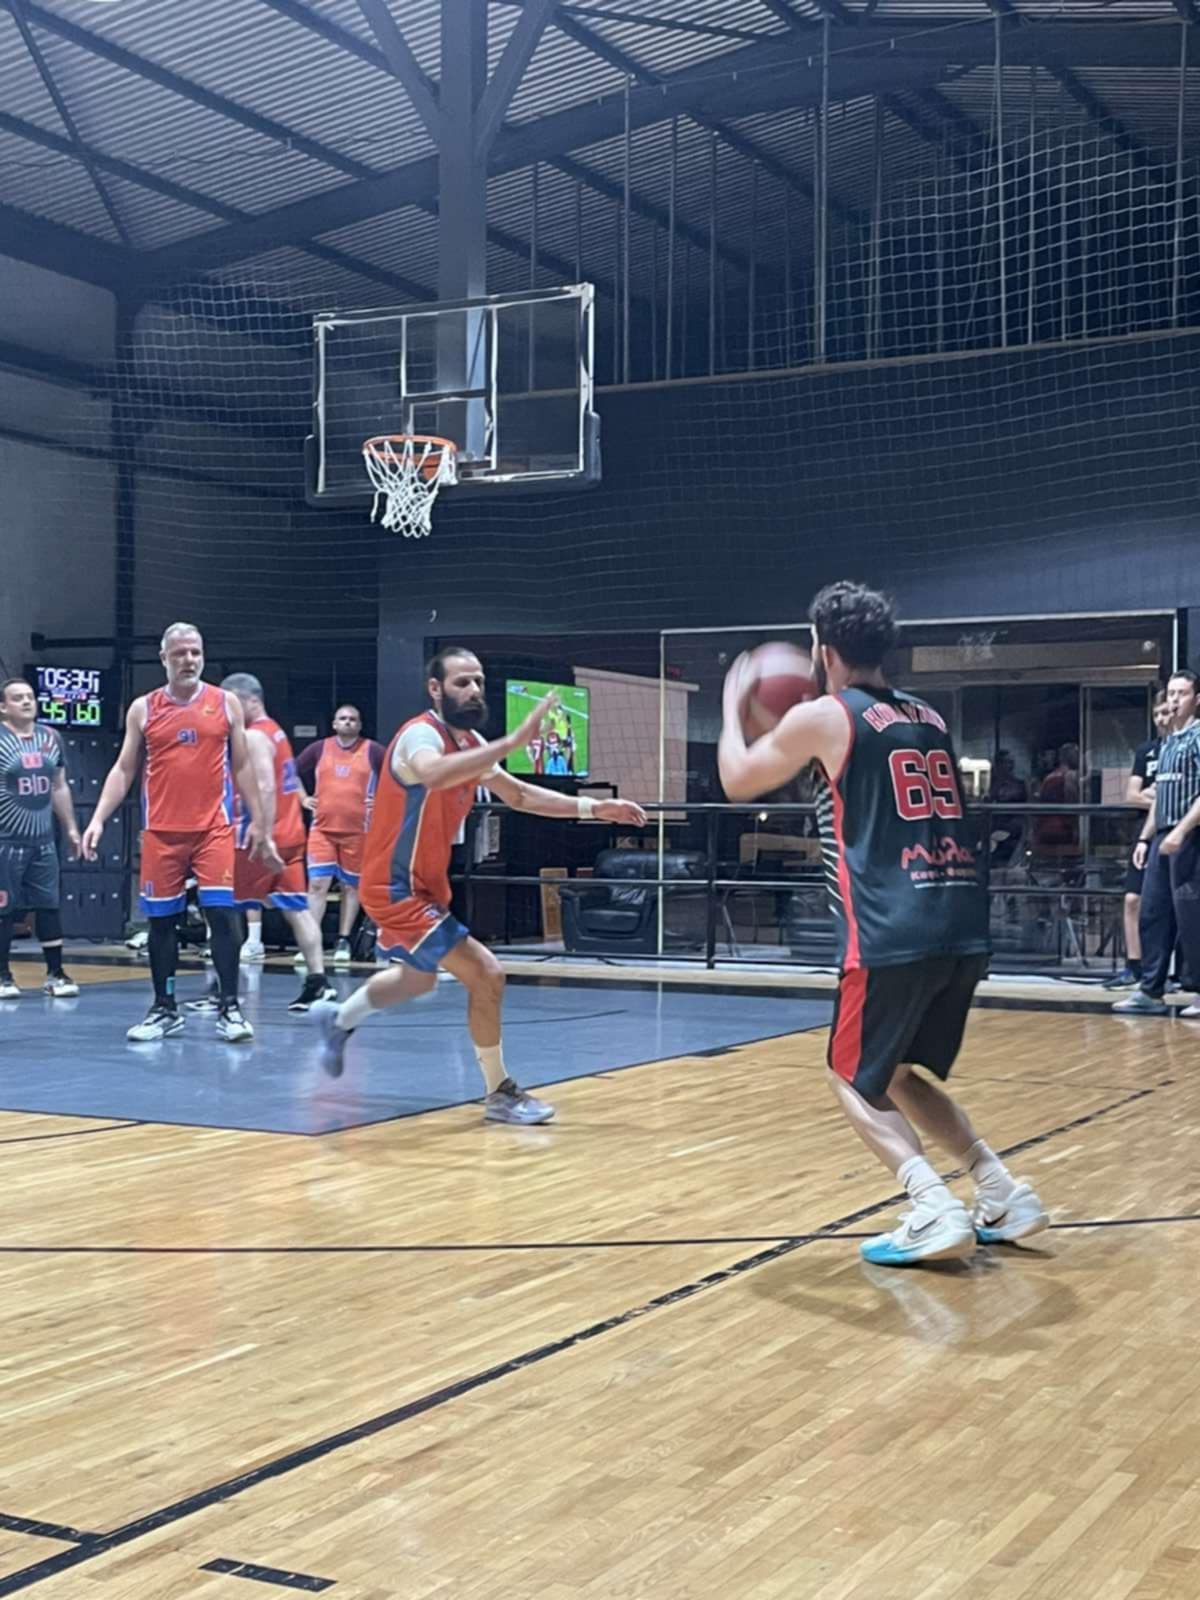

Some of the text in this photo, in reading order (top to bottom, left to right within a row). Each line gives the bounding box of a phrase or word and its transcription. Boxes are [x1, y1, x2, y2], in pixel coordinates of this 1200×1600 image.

[42, 701, 67, 721] 45
[76, 703, 100, 721] 60
[177, 728, 198, 746] 91
[888, 749, 963, 820] 69
